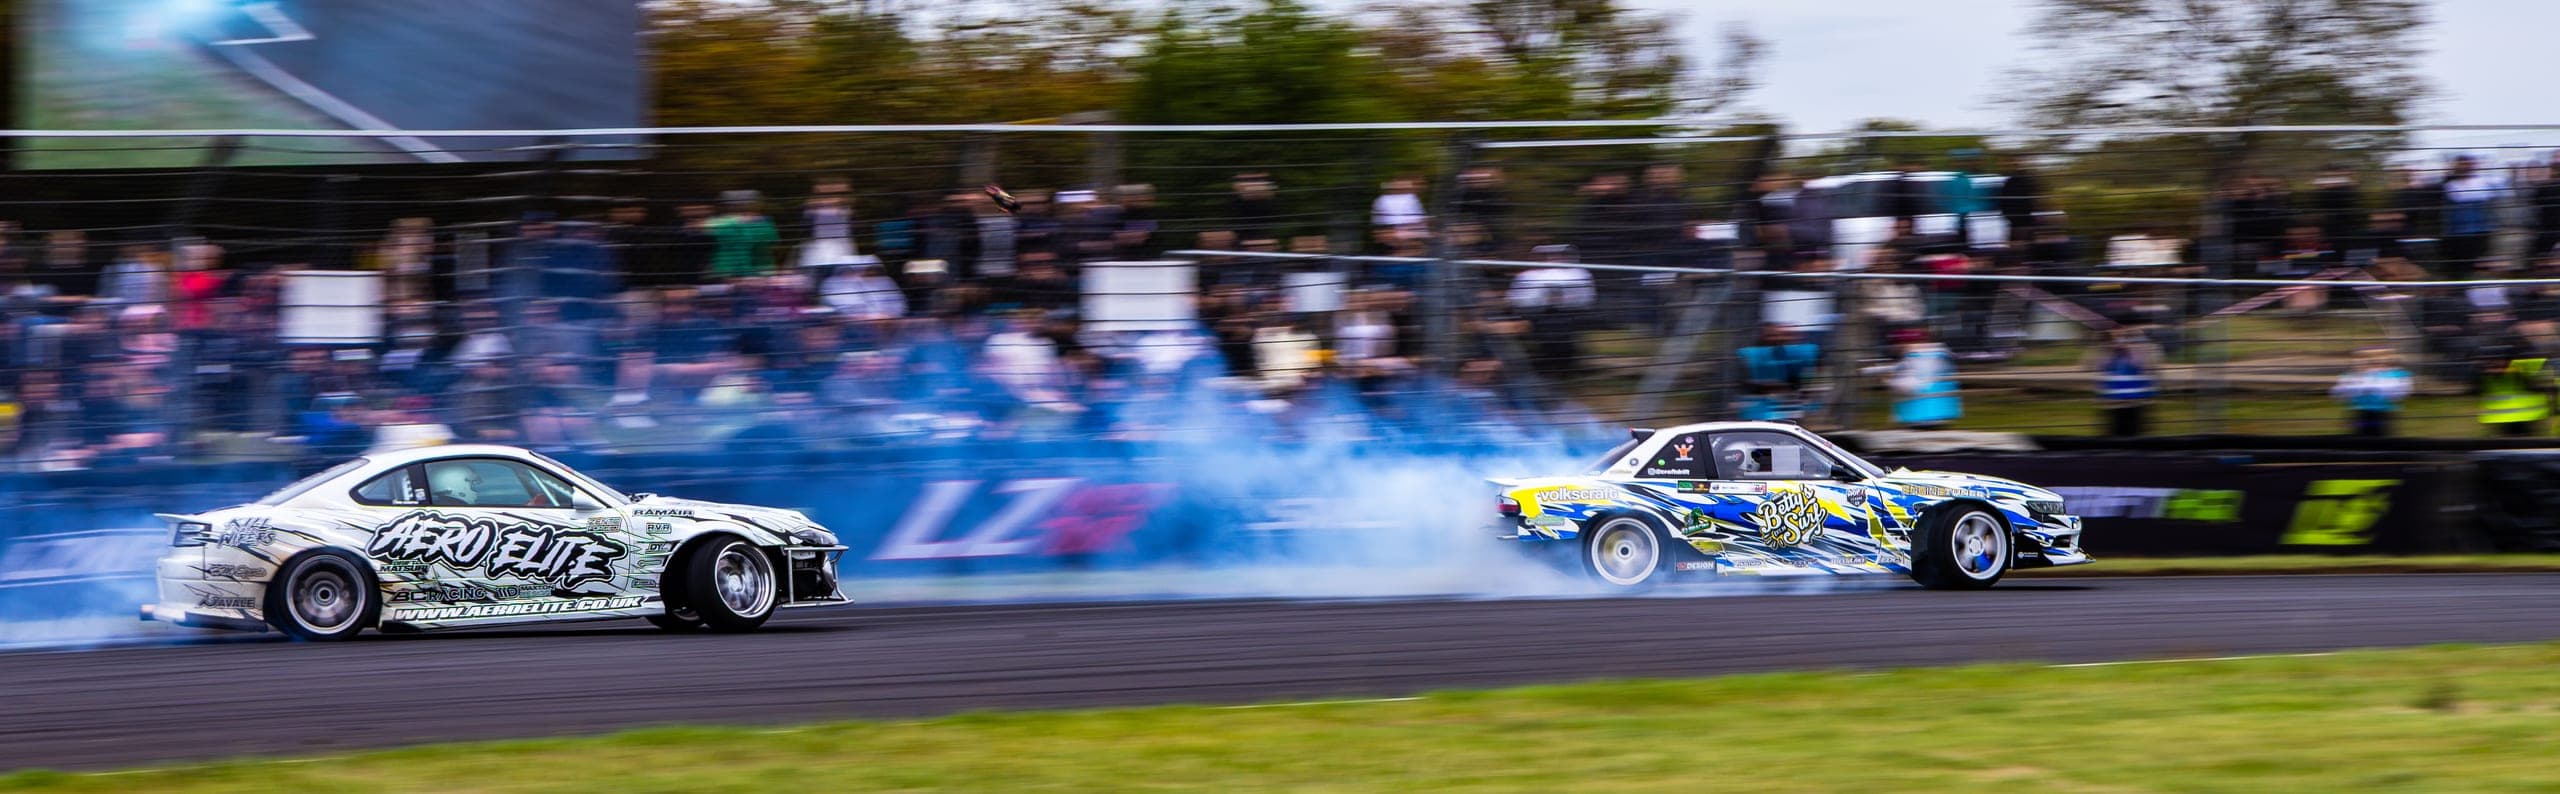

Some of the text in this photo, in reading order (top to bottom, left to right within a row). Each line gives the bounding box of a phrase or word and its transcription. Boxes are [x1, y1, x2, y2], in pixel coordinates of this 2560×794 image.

[1539, 487, 1619, 501] volkscraft
[1758, 483, 1816, 534] Betty's
[633, 509, 696, 517] RAMAIR
[1783, 502, 1827, 545] Surf
[368, 516, 620, 582] AERO ELITE
[394, 595, 645, 621] WWW.AEROELITE.CO.UK
